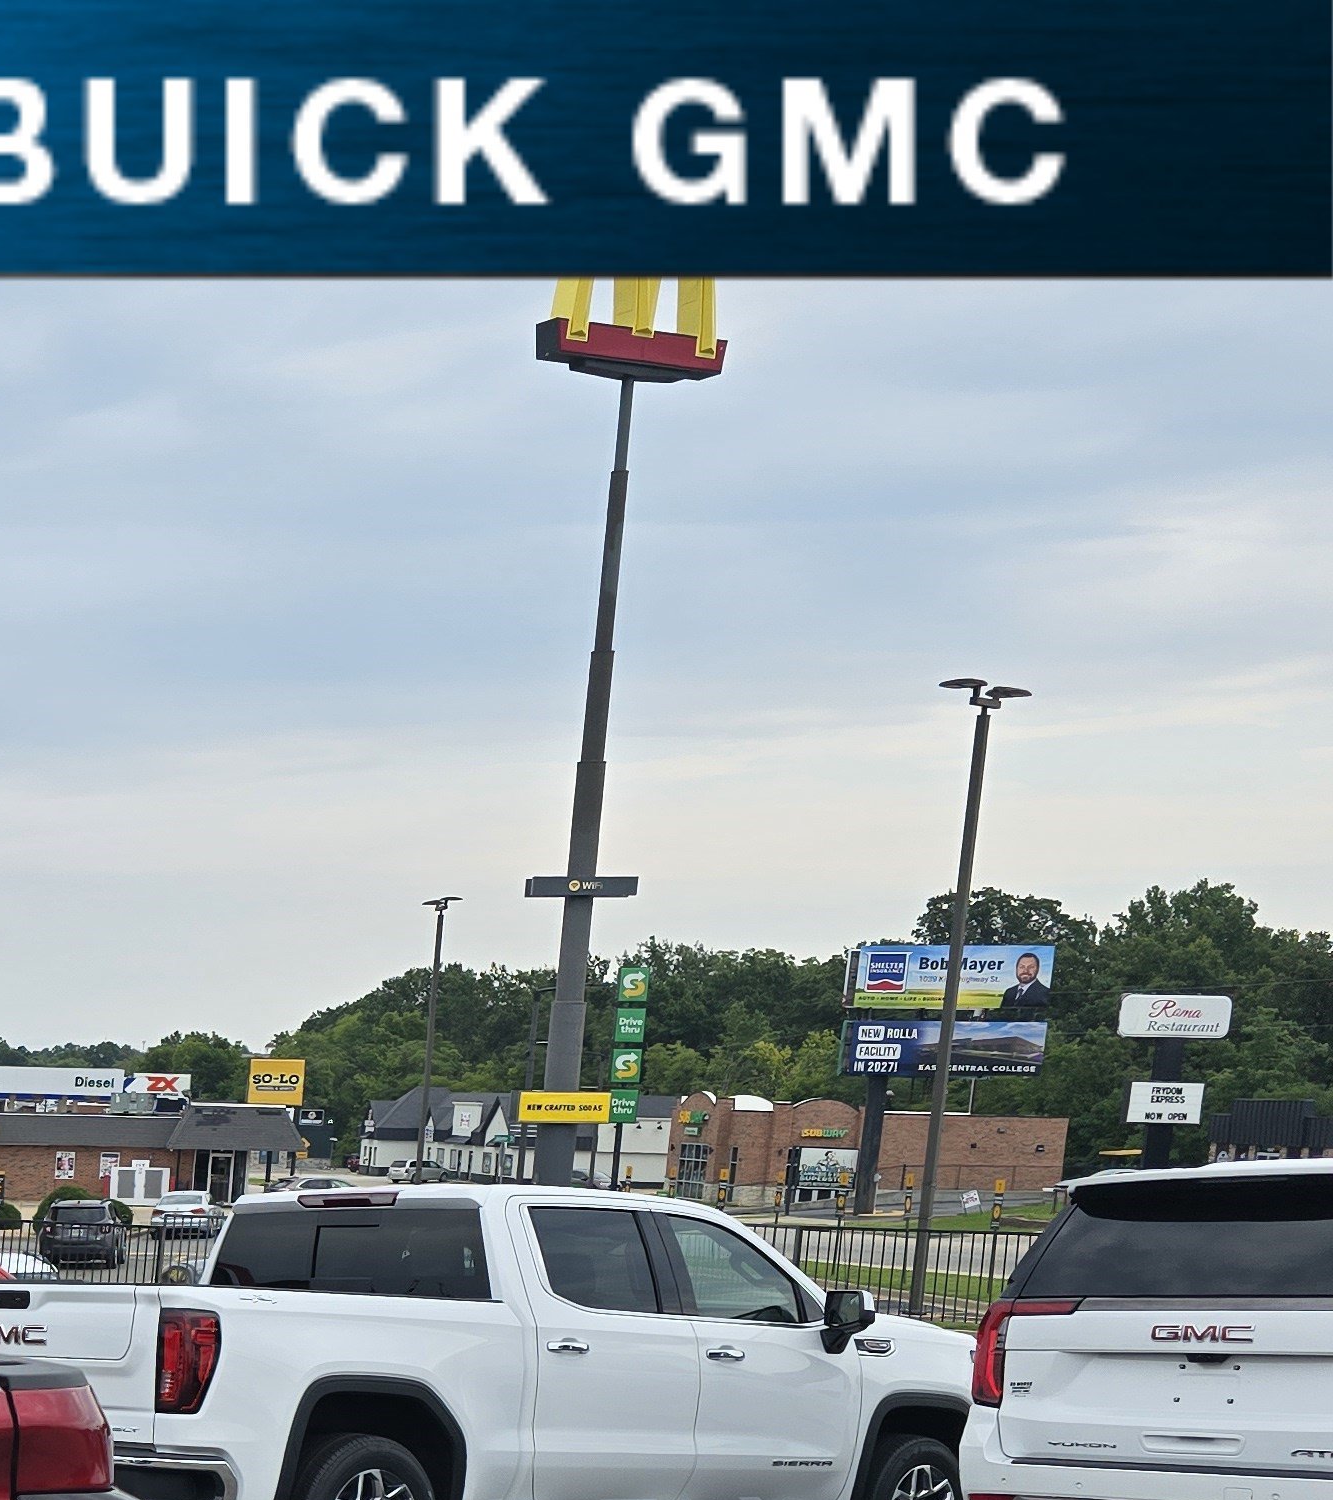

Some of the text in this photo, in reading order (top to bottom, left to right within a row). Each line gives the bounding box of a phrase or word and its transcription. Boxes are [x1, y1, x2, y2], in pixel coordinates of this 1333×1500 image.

[582, 881, 603, 890] WiFi
[919, 957, 948, 970] Bob
[1148, 999, 1203, 1019] Roma
[619, 1017, 643, 1026] Drive
[1145, 1020, 1221, 1033] Restaurant
[621, 1025, 640, 1034] thru
[861, 1028, 918, 1039] NEW ROLLA
[859, 1046, 898, 1056] FACILITY
[853, 1061, 898, 1072] IN 2027!
[992, 1065, 1037, 1073] COLLEGE
[74, 1076, 115, 1089] Diesel
[146, 1076, 180, 1092] ZX
[252, 1073, 300, 1085] SO-LO
[1151, 1086, 1183, 1095] FRYDOM
[611, 1098, 636, 1106] Drive
[1150, 1096, 1185, 1104] EXPRESS
[613, 1106, 633, 1114] thru
[1145, 1112, 1187, 1121] NOW OPEN
[801, 1127, 849, 1138] SUBWAY
[1150, 1323, 1256, 1343] GMC
[1048, 1441, 1117, 1449] YUKON
